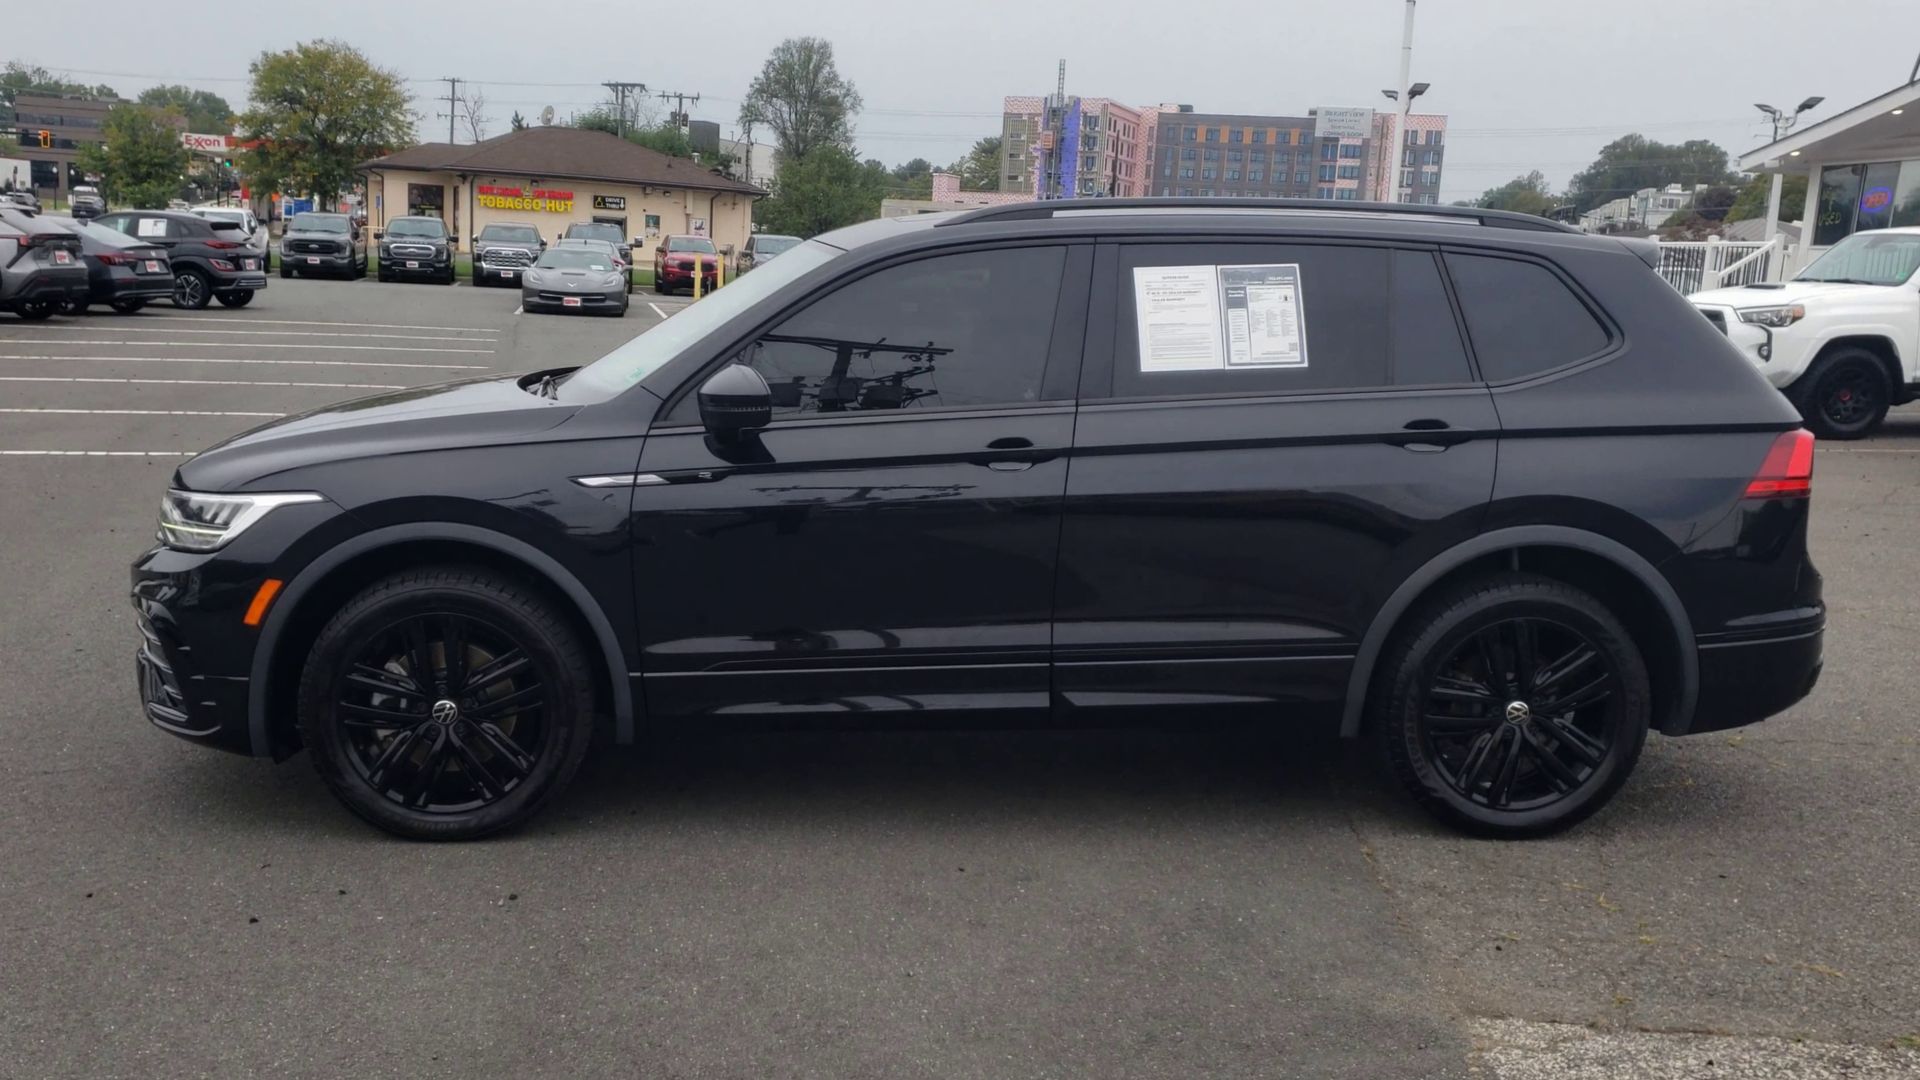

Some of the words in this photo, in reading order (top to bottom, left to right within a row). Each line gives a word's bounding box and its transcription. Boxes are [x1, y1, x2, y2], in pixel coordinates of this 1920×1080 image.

[184, 134, 221, 149] Exxon
[478, 195, 542, 210] TOBACCO
[545, 200, 574, 213] HUT
[1864, 191, 1889, 209] OPEN
